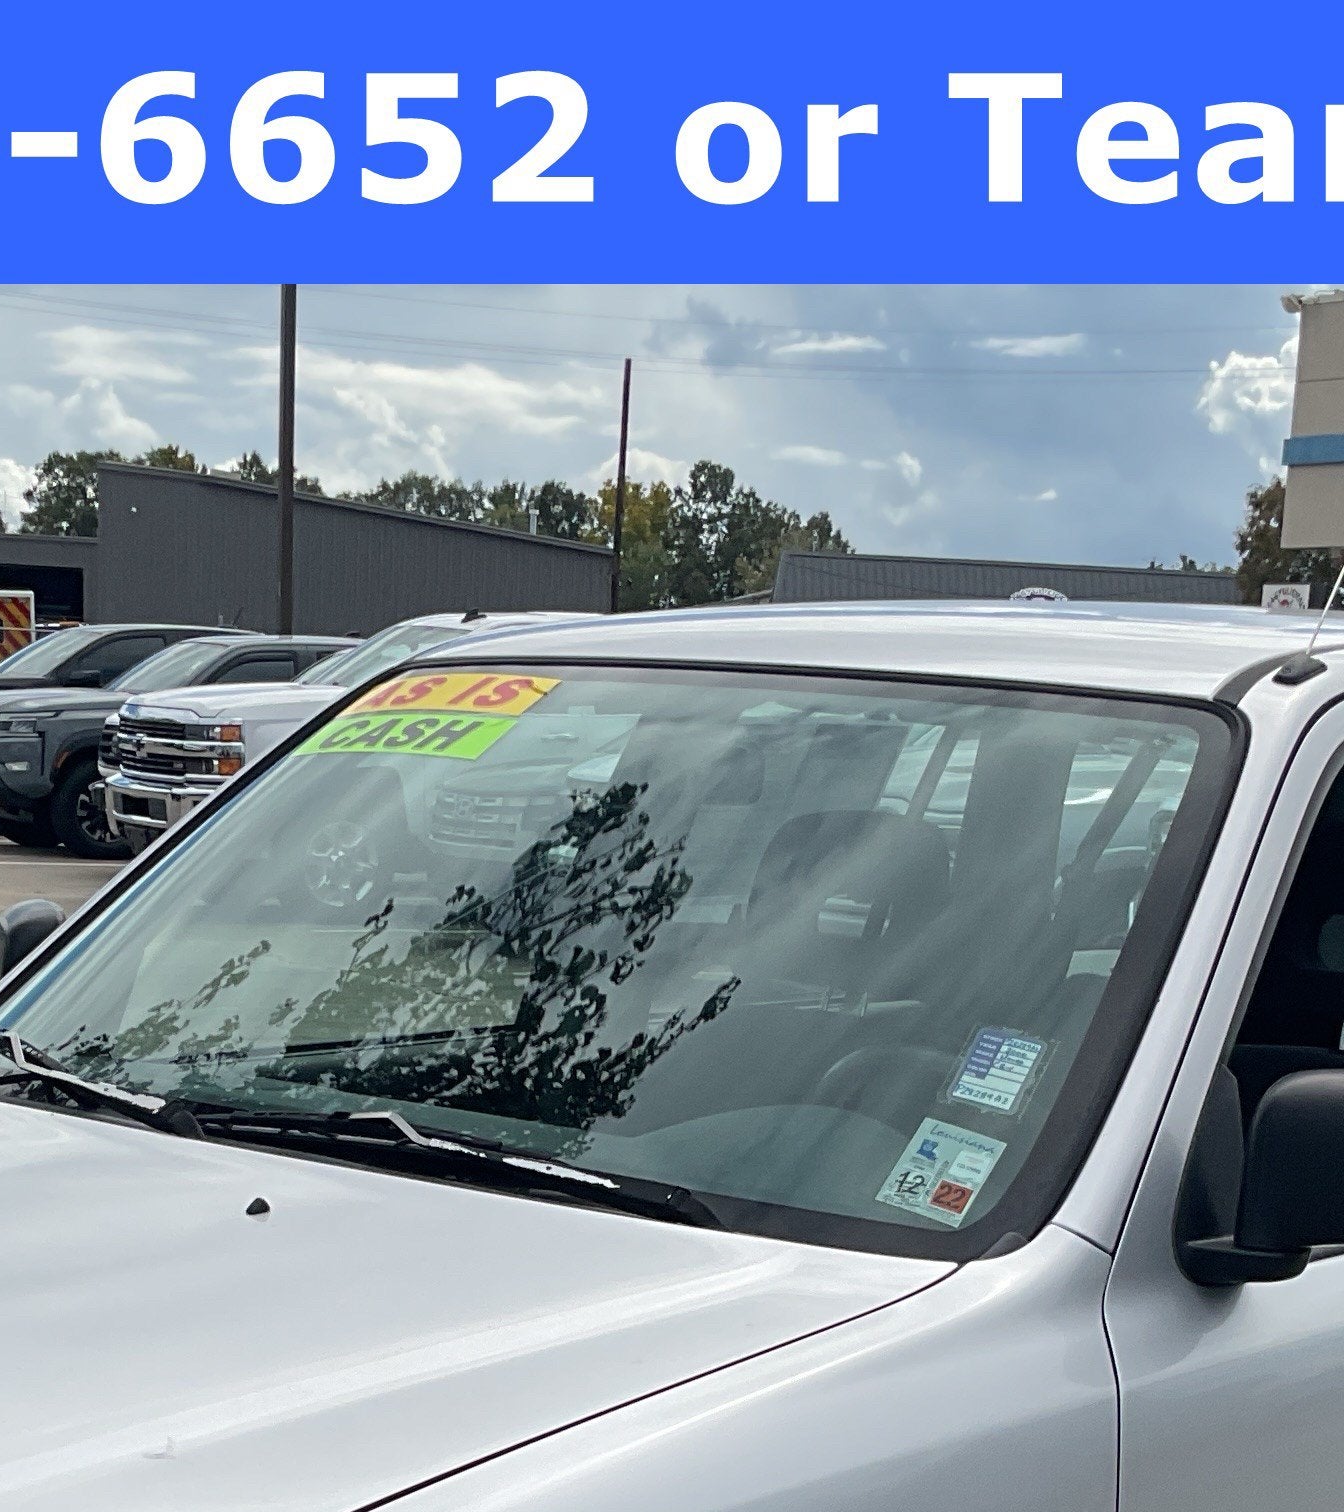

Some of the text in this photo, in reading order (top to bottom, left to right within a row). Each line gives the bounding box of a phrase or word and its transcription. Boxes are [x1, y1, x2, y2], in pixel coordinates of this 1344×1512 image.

[361, 676, 536, 709] AS IS
[318, 717, 486, 751] CASH
